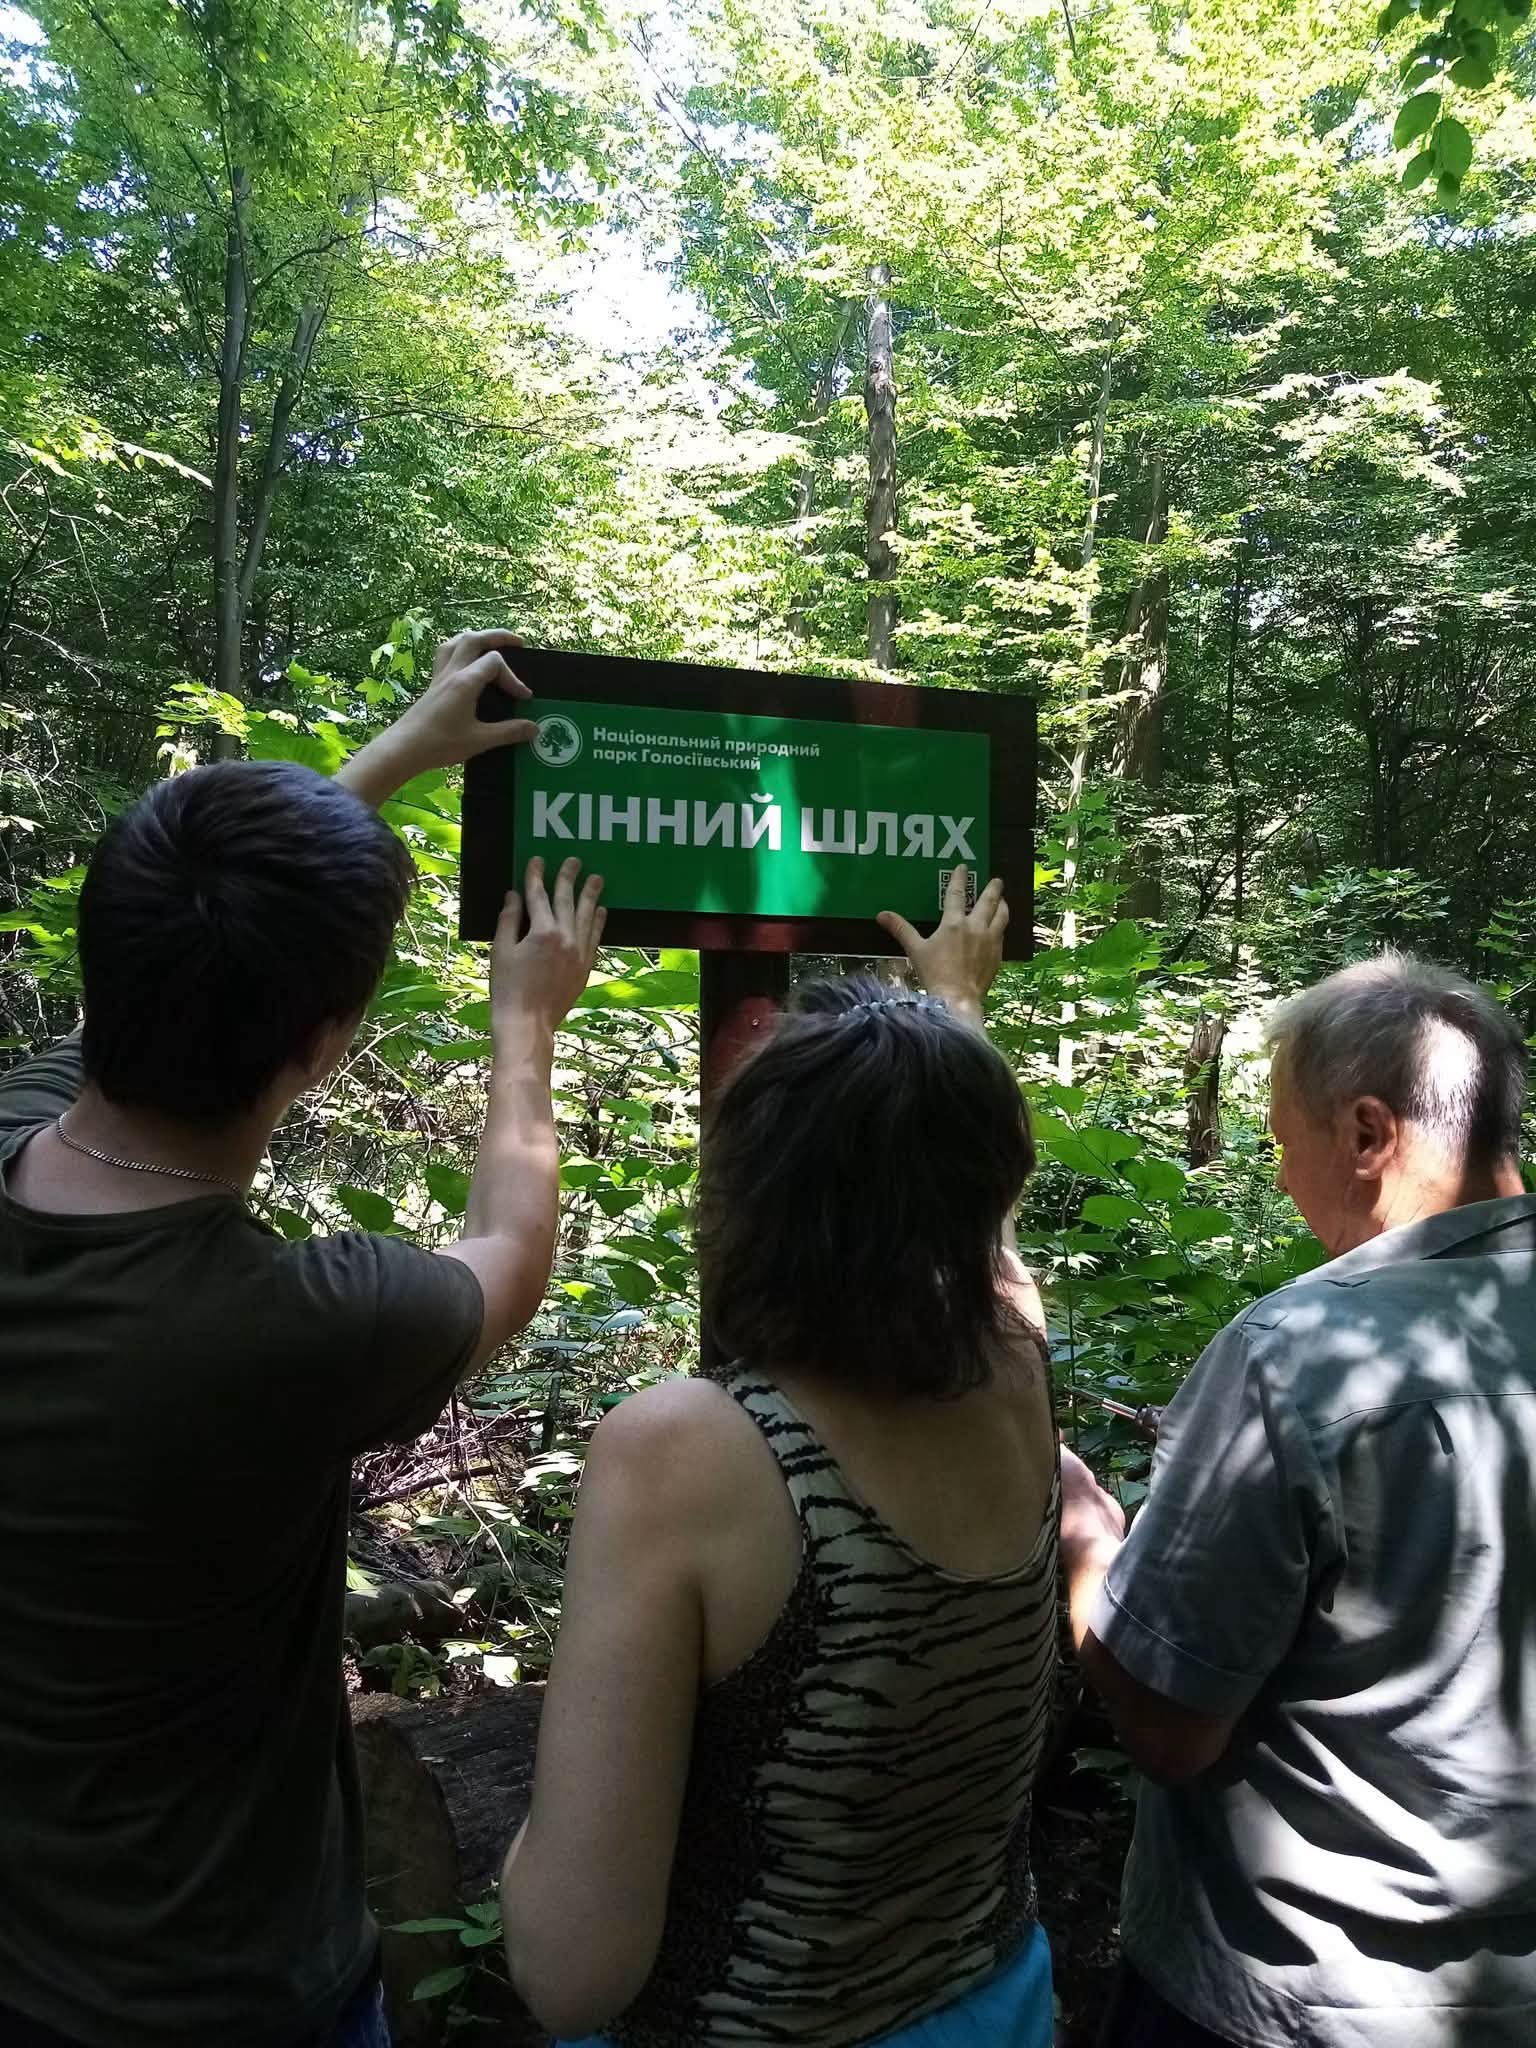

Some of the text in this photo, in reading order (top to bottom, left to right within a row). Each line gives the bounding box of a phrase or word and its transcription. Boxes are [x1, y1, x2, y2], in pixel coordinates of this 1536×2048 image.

[593, 727, 820, 757] Національний природний
[593, 748, 761, 771] парк Голосіївський
[532, 790, 977, 861] КІННИЙ ШЛЯХ
